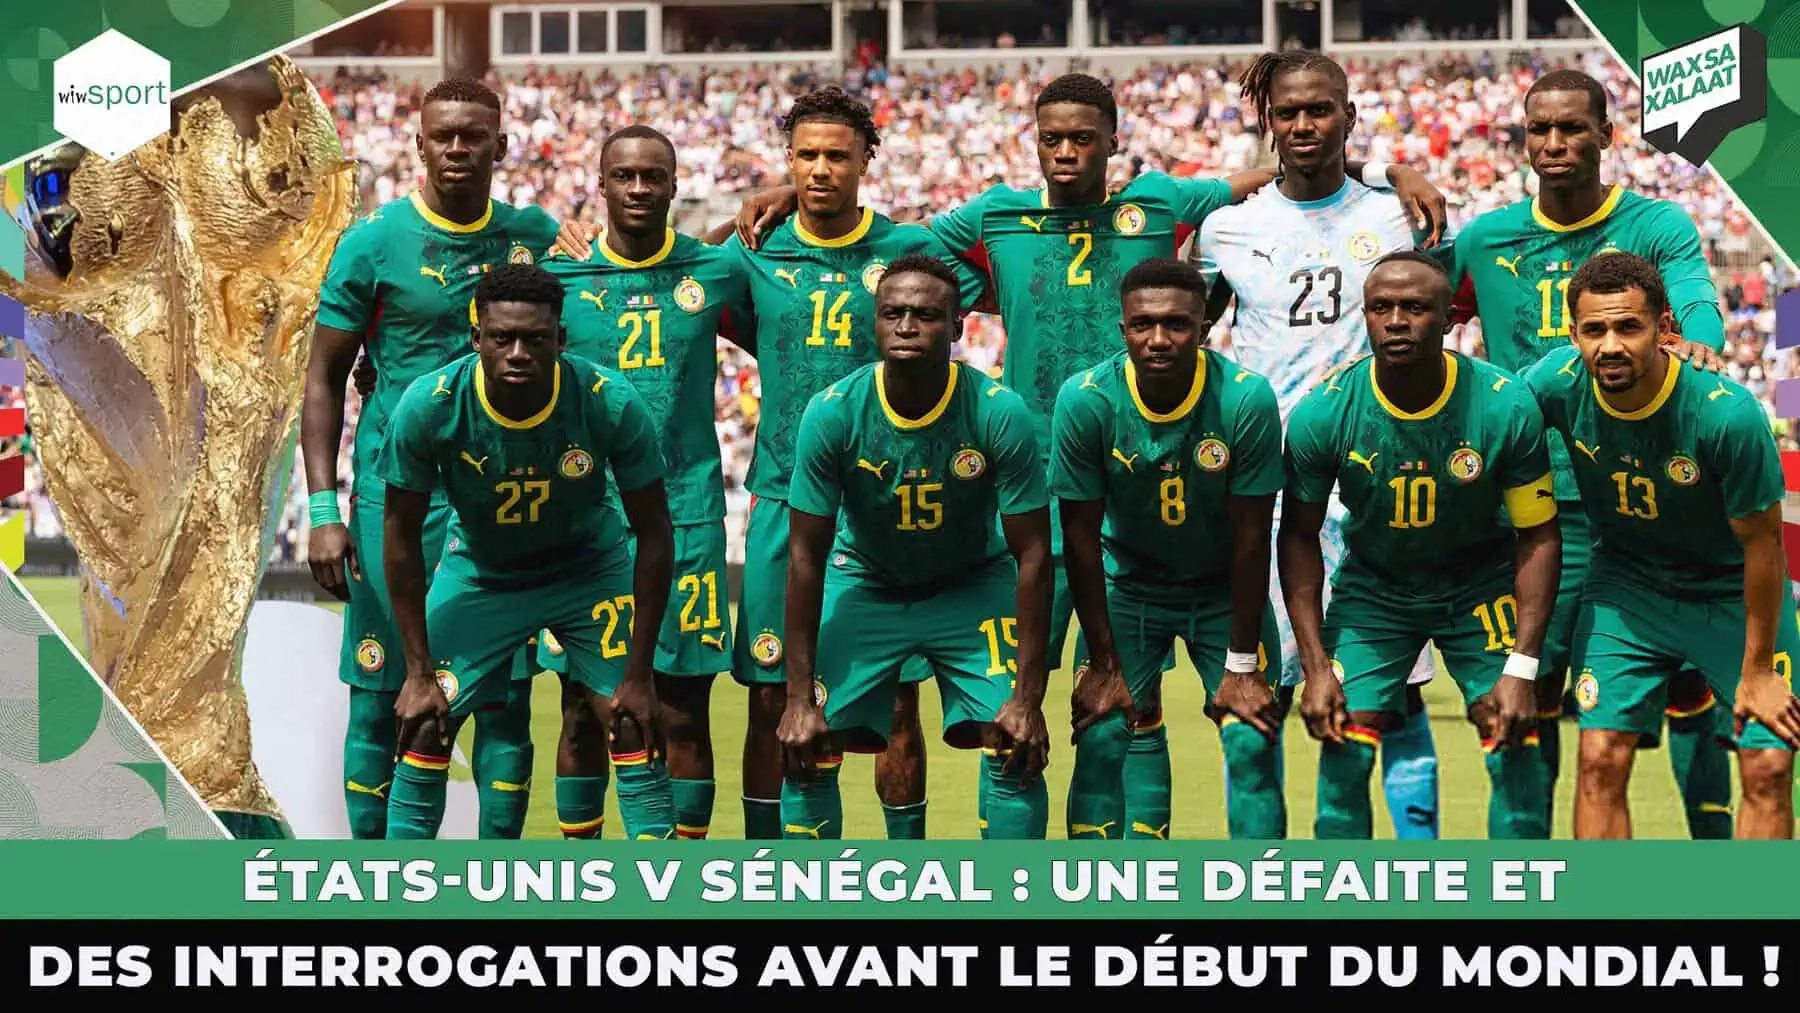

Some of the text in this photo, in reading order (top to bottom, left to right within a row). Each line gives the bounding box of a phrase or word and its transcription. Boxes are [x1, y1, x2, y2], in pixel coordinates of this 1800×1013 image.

[1067, 232, 1093, 286] 2
[805, 289, 852, 348] 14
[1288, 265, 1343, 328] 23
[617, 309, 666, 370] 21
[495, 479, 550, 525] 27
[894, 482, 944, 531] 15
[1159, 476, 1186, 526] 8
[1387, 475, 1438, 530] 10
[1609, 470, 1659, 520] 13
[677, 570, 722, 634] 21
[1471, 594, 1518, 651] 10
